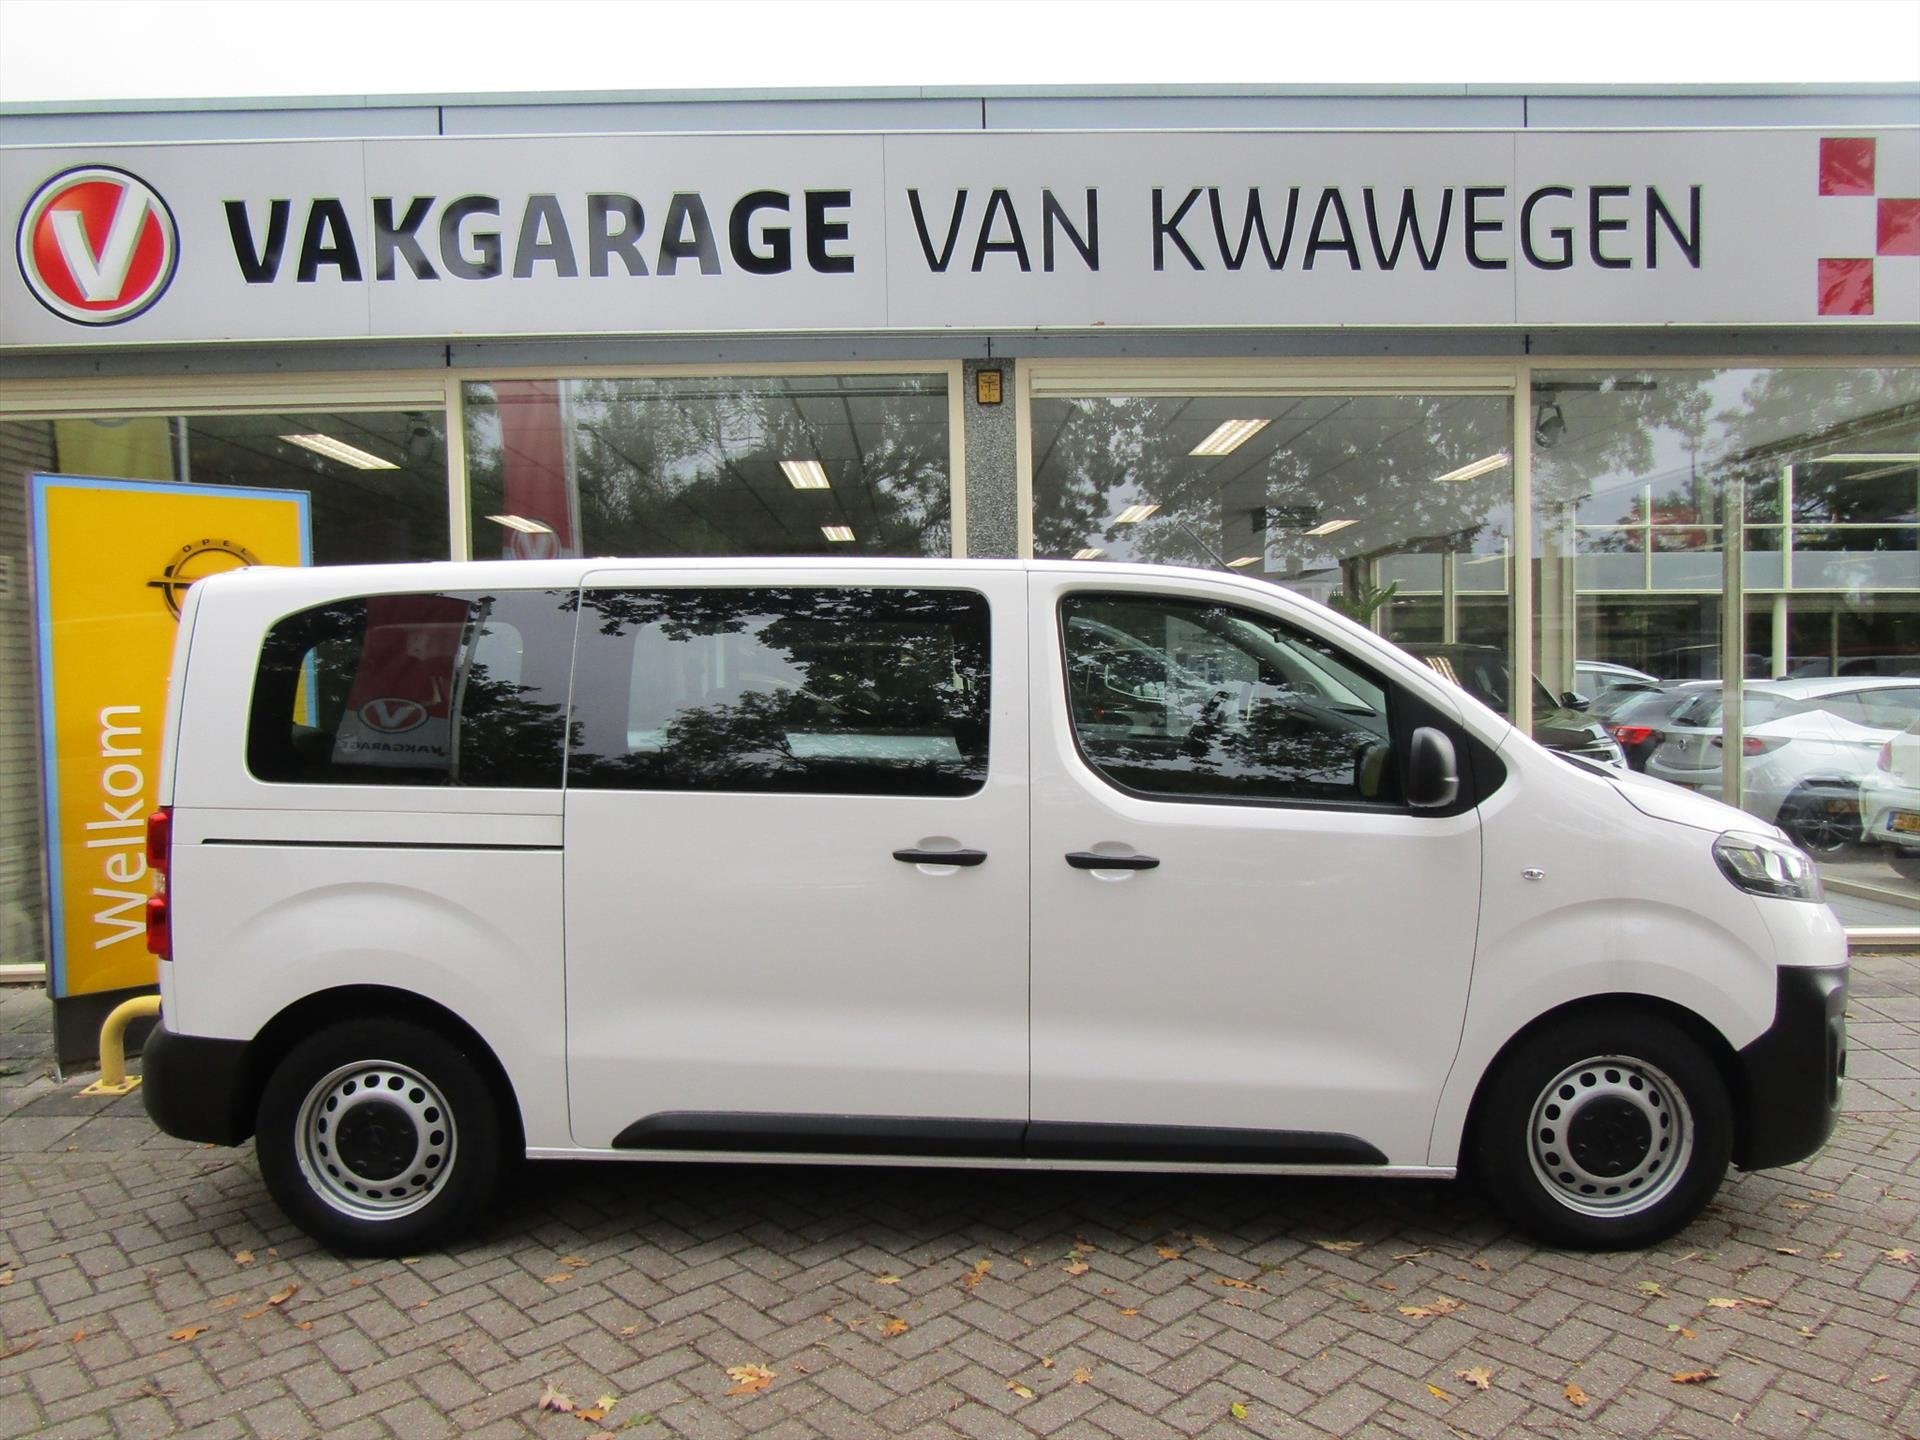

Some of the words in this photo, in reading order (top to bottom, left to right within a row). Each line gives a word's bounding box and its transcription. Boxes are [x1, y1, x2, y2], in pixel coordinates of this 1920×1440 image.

[51, 179, 151, 302] V
[223, 188, 854, 284] VAKGARAGE
[907, 188, 1099, 273] VAN
[1152, 184, 1702, 271] KWAWEGEN
[182, 538, 248, 556] OPEL
[86, 705, 147, 949] Welkom
